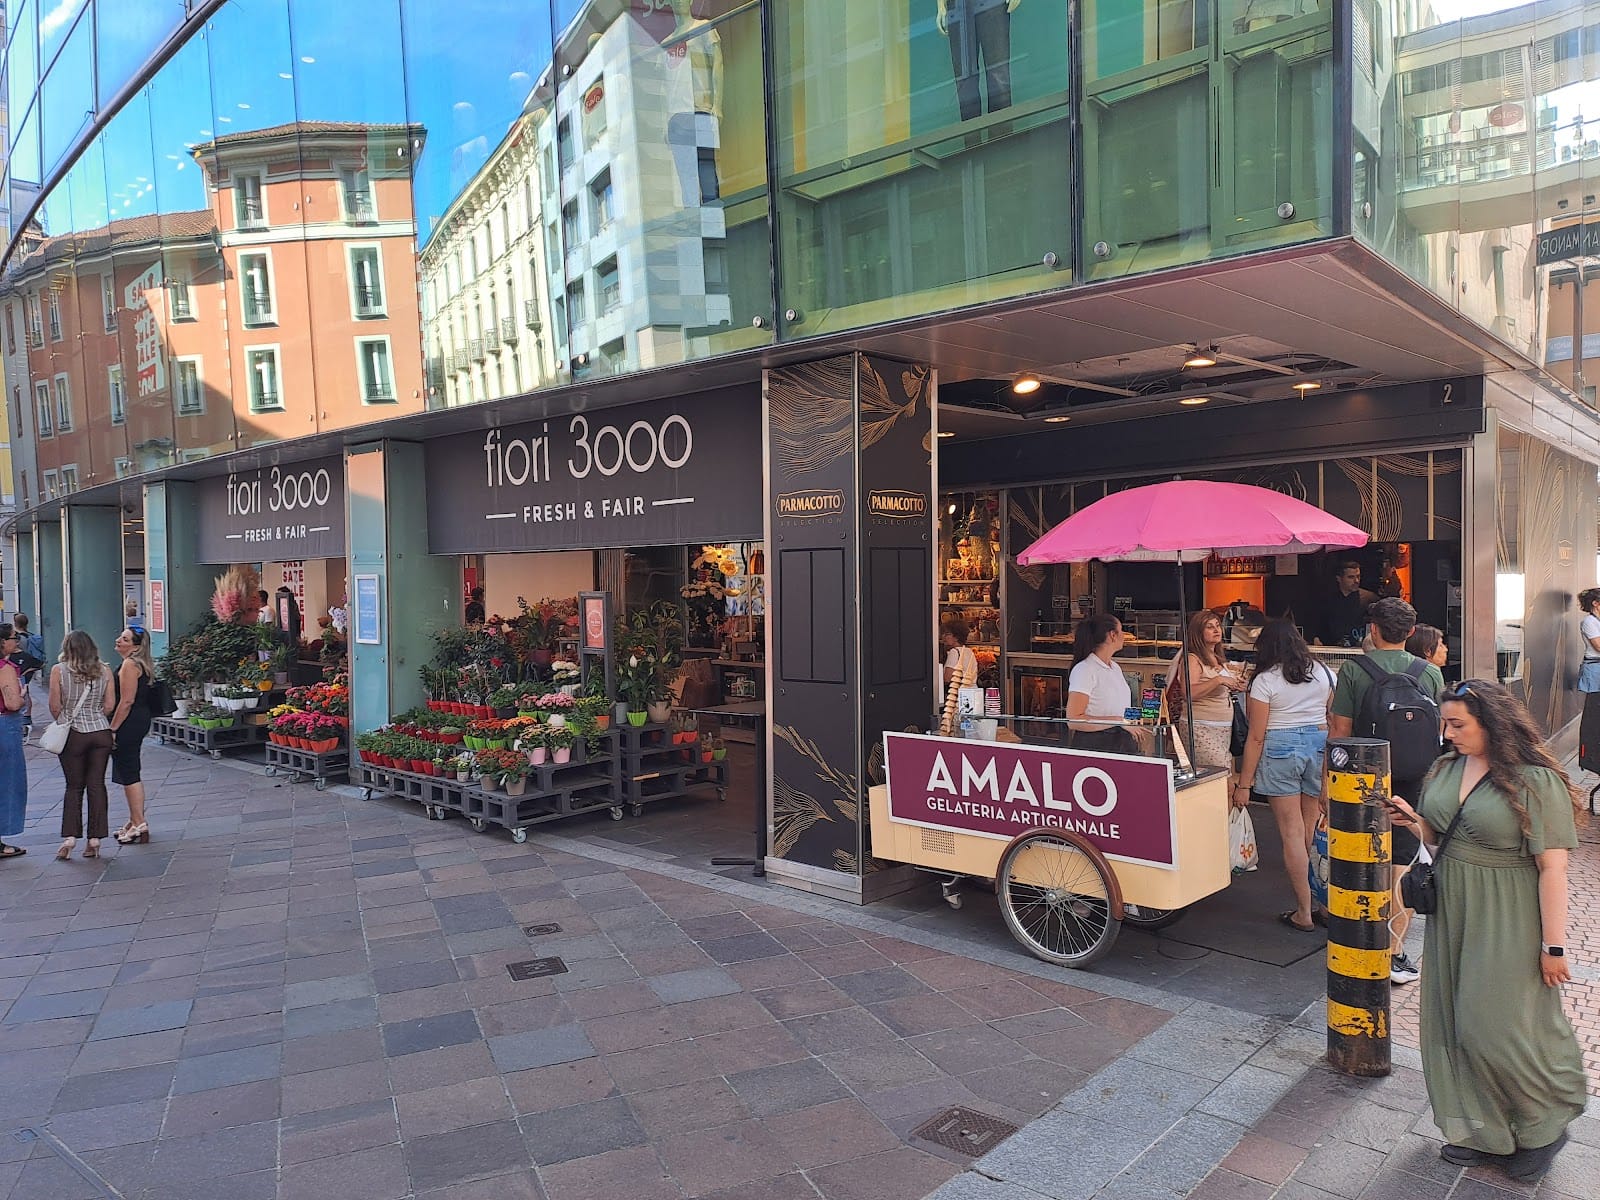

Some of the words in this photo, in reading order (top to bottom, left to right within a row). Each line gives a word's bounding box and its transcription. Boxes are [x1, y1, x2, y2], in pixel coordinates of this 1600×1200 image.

[1443, 383, 1453, 403] 2
[484, 423, 550, 487] fiori
[568, 415, 693, 479] 3000
[226, 473, 261, 515] fiori
[269, 466, 331, 511] 3000
[780, 495, 841, 512] PARMACOTTO
[871, 495, 924, 512] PARMACOTTO
[523, 502, 577, 523] FRESH
[584, 500, 594, 519] &
[602, 496, 645, 517] FAIR
[244, 528, 273, 542] FRESH
[275, 527, 283, 539] &
[285, 525, 307, 539] FAIR
[926, 750, 1118, 816] AMALO
[927, 797, 1005, 821] GELATERIA
[1010, 812, 1121, 840] ARTIGIANALE
